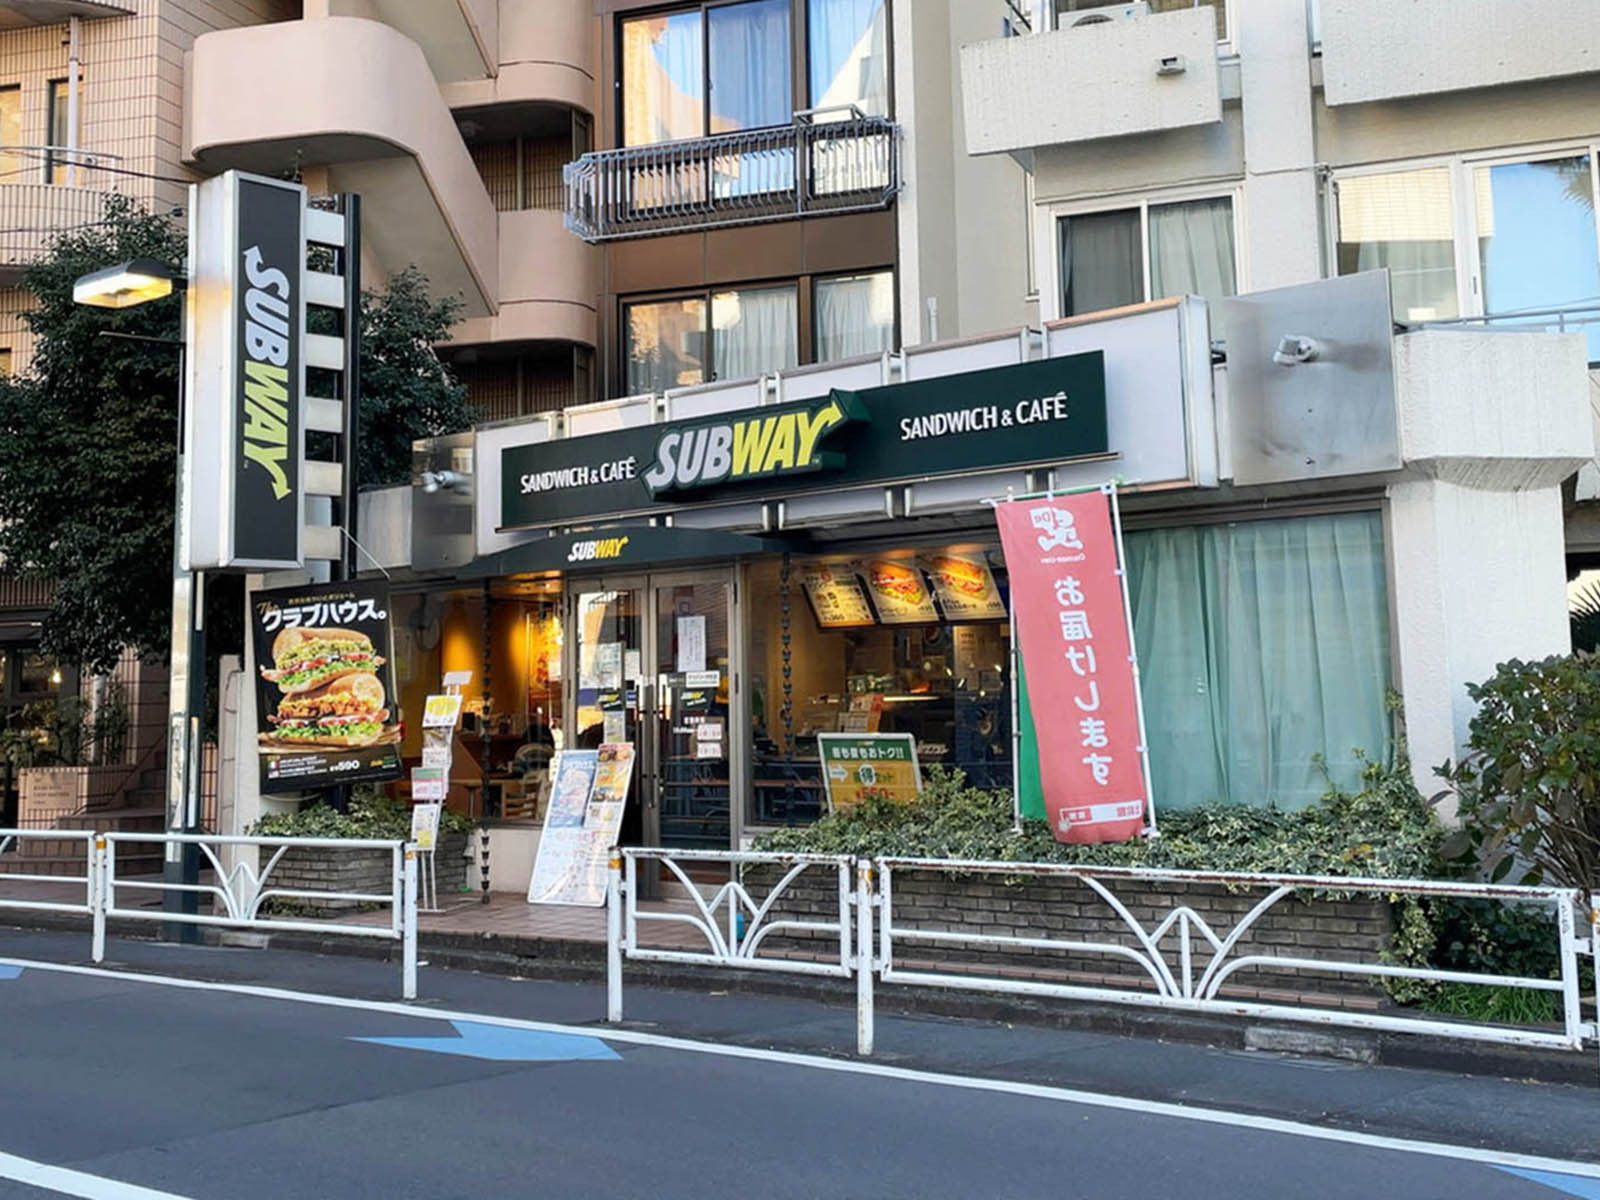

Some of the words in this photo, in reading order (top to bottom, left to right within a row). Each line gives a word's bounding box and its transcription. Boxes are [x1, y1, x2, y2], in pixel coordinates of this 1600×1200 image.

[243, 245, 292, 500] SUBWAY
[900, 406, 998, 441] SANDWICH
[1001, 409, 1014, 426] &
[1016, 391, 1068, 424] CAFÉ
[645, 401, 843, 489] SUBWAY
[521, 466, 589, 494] SANDWICH
[590, 469, 599, 484] &
[600, 456, 636, 482] CAFÉ
[568, 536, 629, 562] SUBWAY
